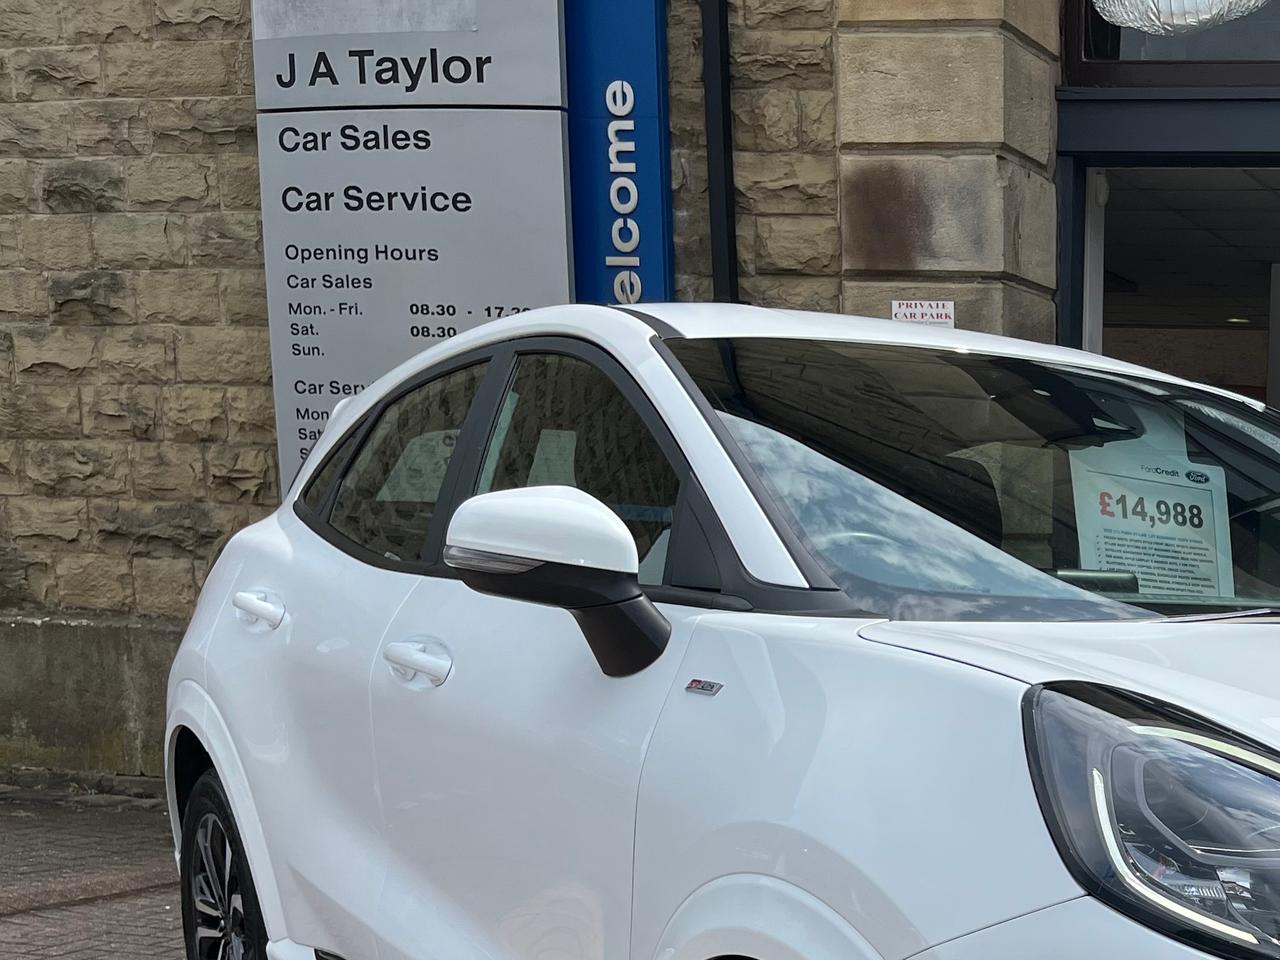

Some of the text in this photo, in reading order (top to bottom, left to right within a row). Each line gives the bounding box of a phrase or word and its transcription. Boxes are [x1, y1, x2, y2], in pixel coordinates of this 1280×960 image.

[276, 48, 492, 92] J A Taylor
[278, 124, 431, 152] Car Sales
[281, 185, 472, 212] Car Service
[285, 244, 439, 264] Opening Hours
[286, 274, 373, 289] Car Sales
[288, 302, 326, 315] Mon.
[338, 302, 363, 315] Fri.
[409, 303, 457, 316] 08.30
[920, 312, 952, 320] PARK
[290, 322, 457, 338] Sat. 08.30
[291, 343, 325, 356] Sun.
[294, 380, 325, 395] Car
[296, 407, 330, 420] Mon
[1099, 491, 1204, 529] £14,988
